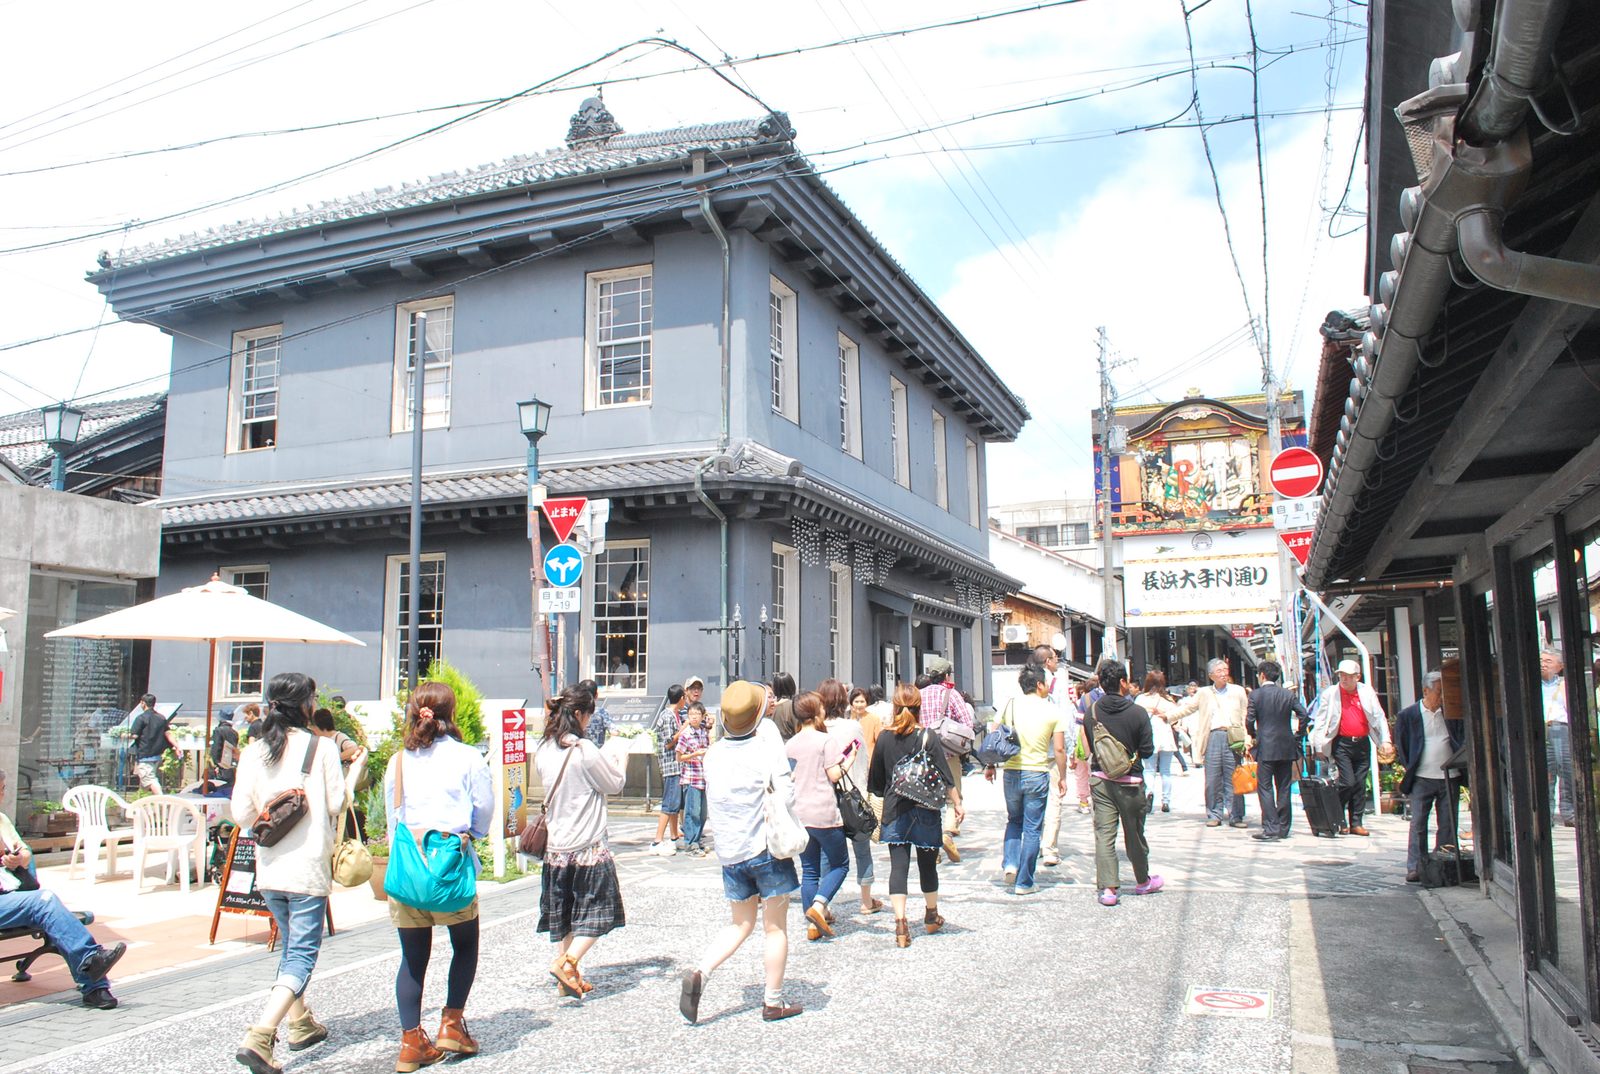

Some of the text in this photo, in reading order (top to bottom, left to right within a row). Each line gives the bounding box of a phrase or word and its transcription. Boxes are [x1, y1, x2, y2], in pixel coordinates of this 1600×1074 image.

[550, 507, 578, 518] 止まれ
[1141, 566, 1268, 591] 長浜大手門通り
[543, 590, 576, 599] 自動車
[548, 601, 571, 610] 7-19
[505, 740, 524, 752] 会場
